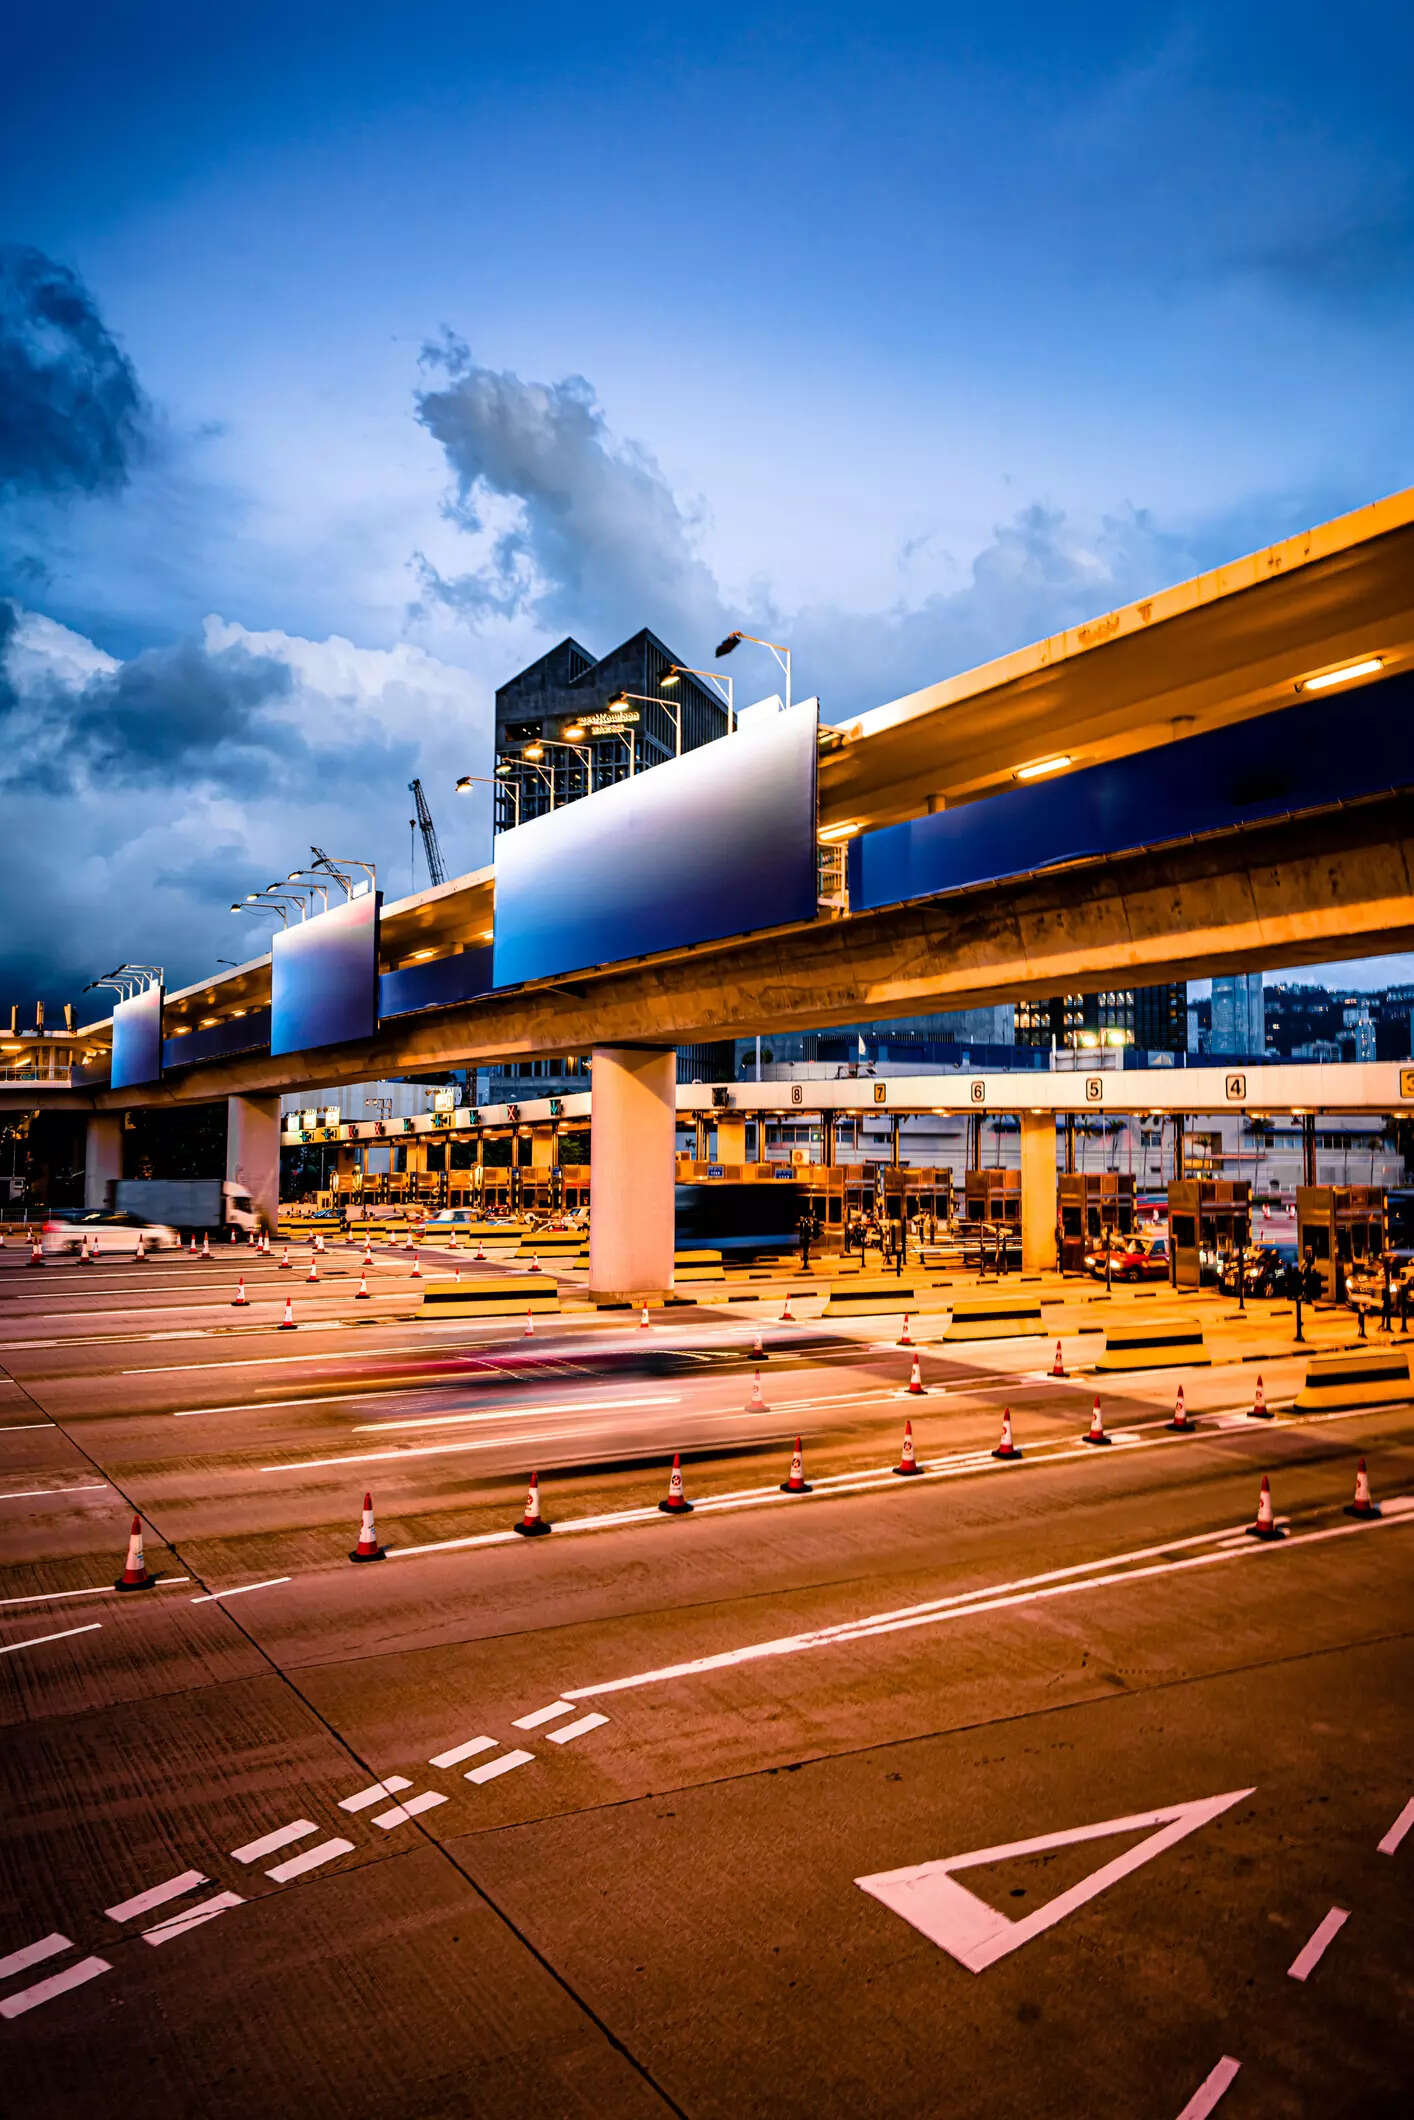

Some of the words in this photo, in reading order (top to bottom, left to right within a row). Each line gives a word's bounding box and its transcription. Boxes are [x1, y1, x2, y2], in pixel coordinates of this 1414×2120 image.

[793, 1088, 800, 1101] 8
[877, 1087, 883, 1099] 7
[974, 1085, 982, 1099] 6
[1090, 1082, 1099, 1097] 5
[1230, 1079, 1241, 1096] 4
